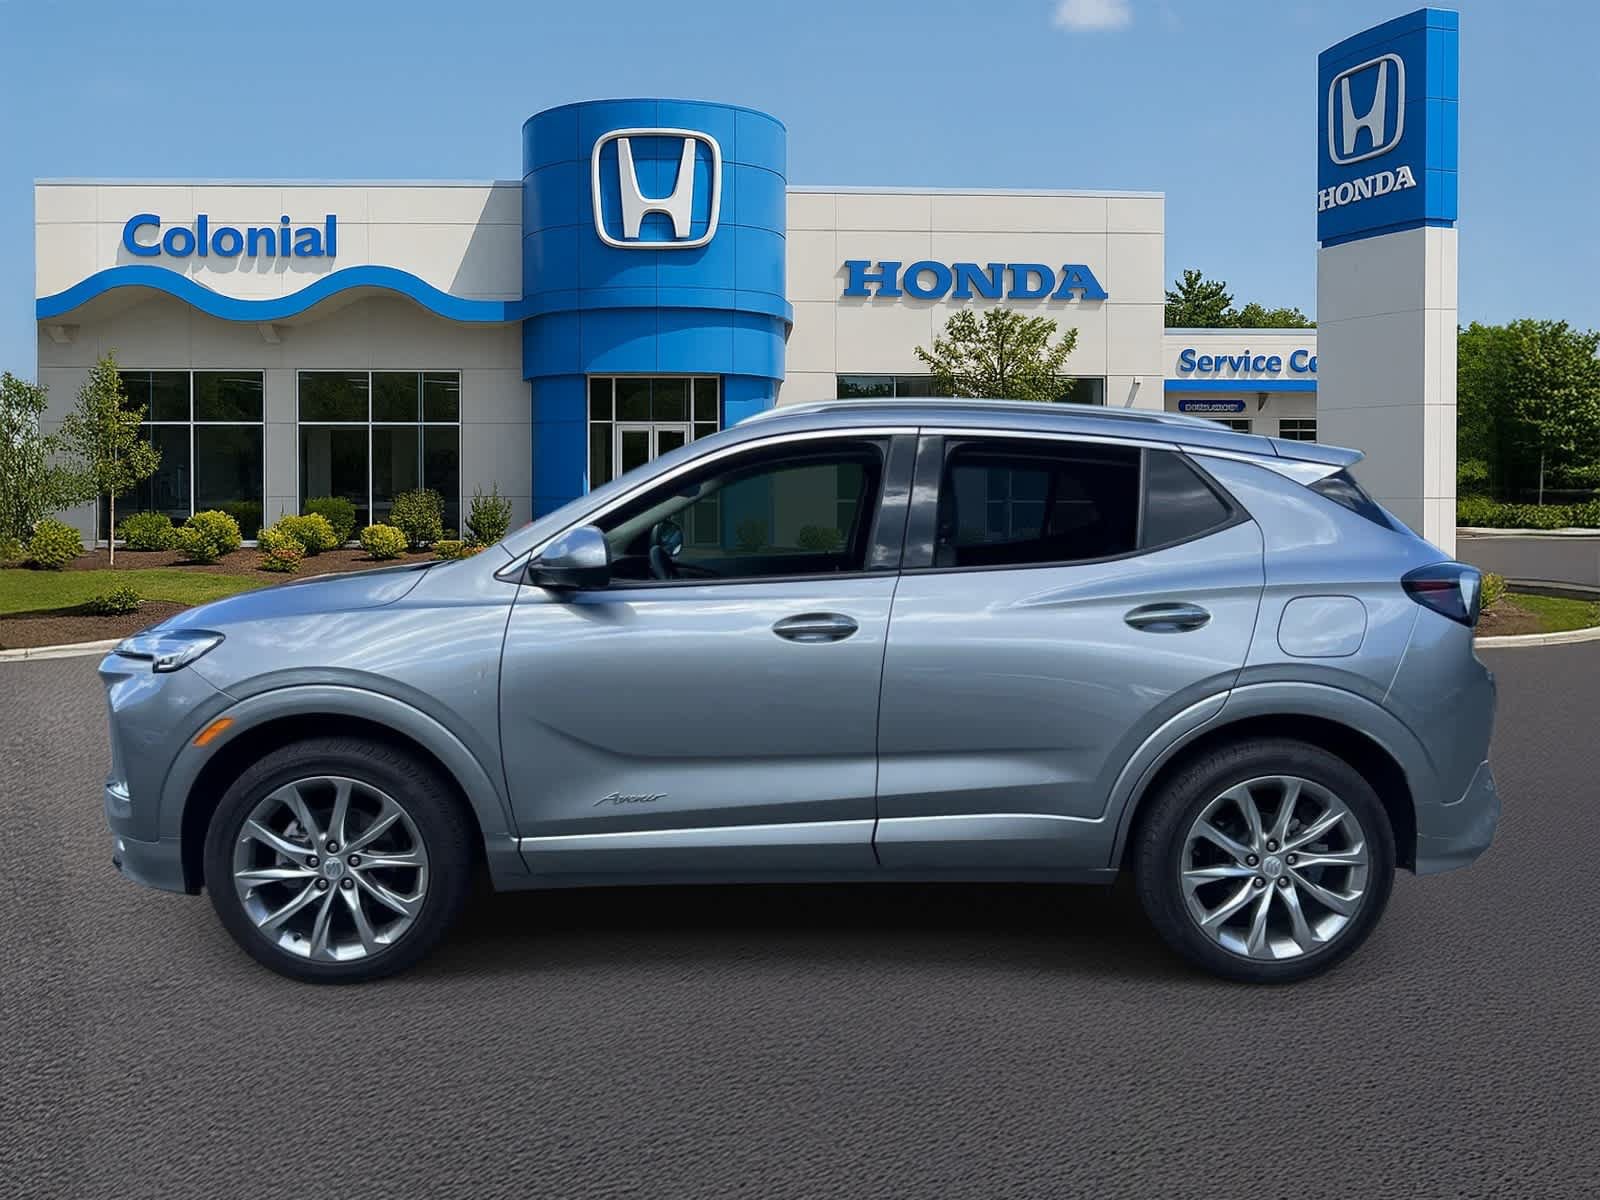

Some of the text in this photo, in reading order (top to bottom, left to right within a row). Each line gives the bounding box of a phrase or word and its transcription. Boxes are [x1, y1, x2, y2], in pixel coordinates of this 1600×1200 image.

[1318, 165, 1417, 212] HONDA
[122, 213, 337, 257] Colonial
[843, 260, 1109, 300] HONDA
[1180, 348, 1282, 373] Service
